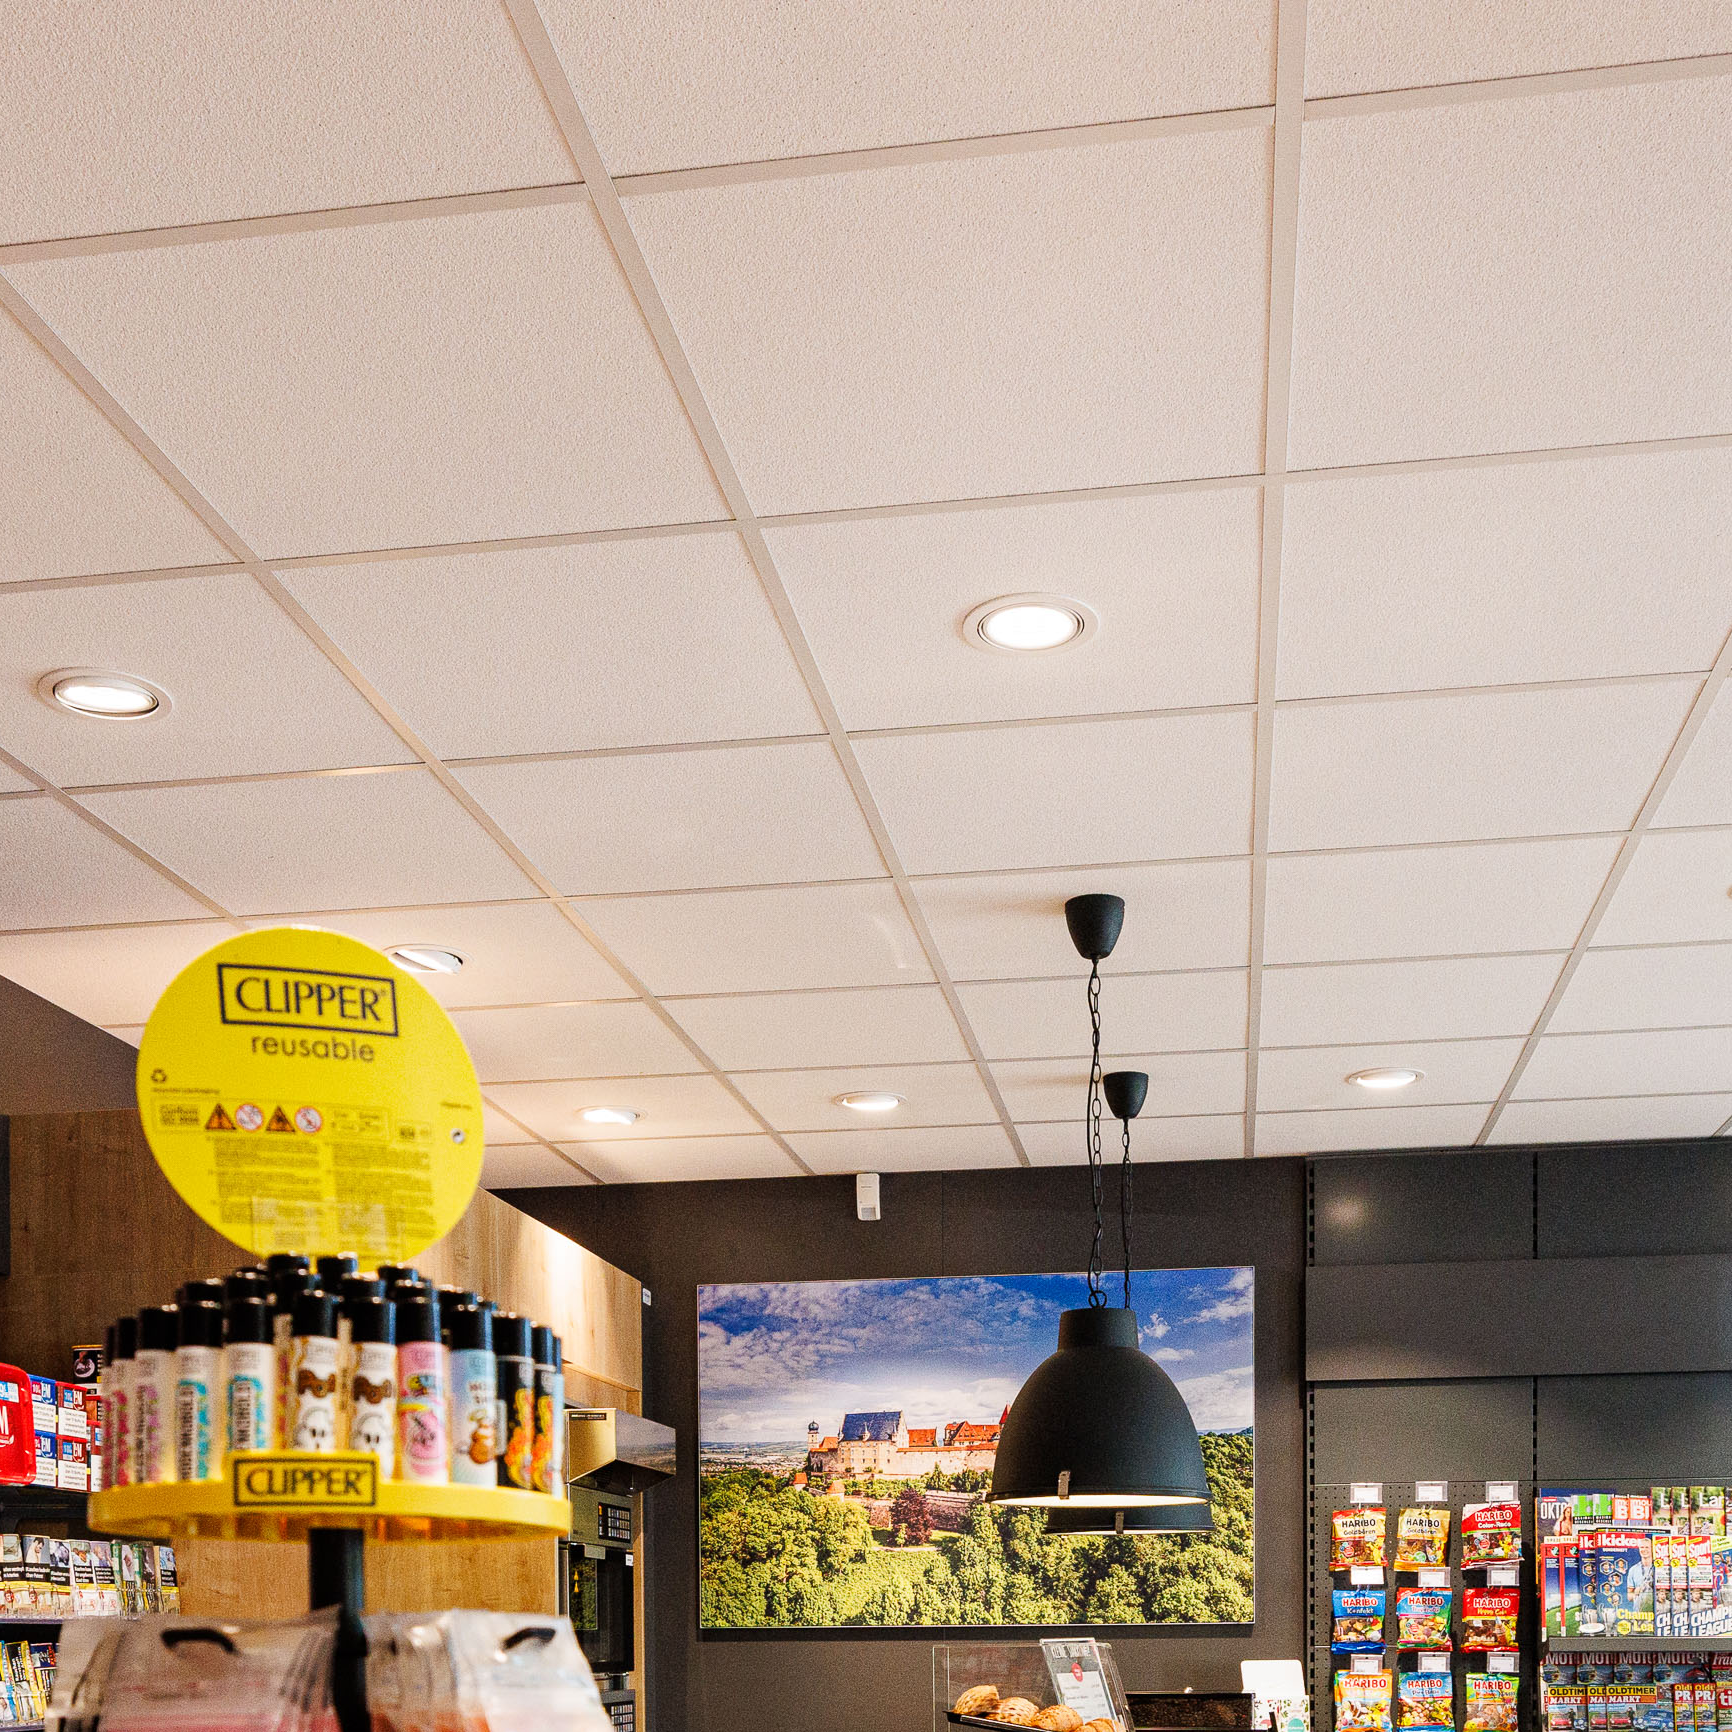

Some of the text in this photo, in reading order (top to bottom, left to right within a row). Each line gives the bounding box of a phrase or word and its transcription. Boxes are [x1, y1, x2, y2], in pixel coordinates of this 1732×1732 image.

[235, 975, 383, 1024] CLIPPER
[250, 1033, 376, 1065] reusable
[245, 1465, 369, 1499] CLIPPER
[1475, 1511, 1512, 1521] HARIBO
[1342, 1519, 1376, 1528] HARIBO
[1342, 1598, 1378, 1607] HARIBO
[1408, 1596, 1444, 1606] HARIBO
[1608, 1687, 1655, 1695] OLDTIMER
[1608, 1695, 1641, 1703] MARKT
